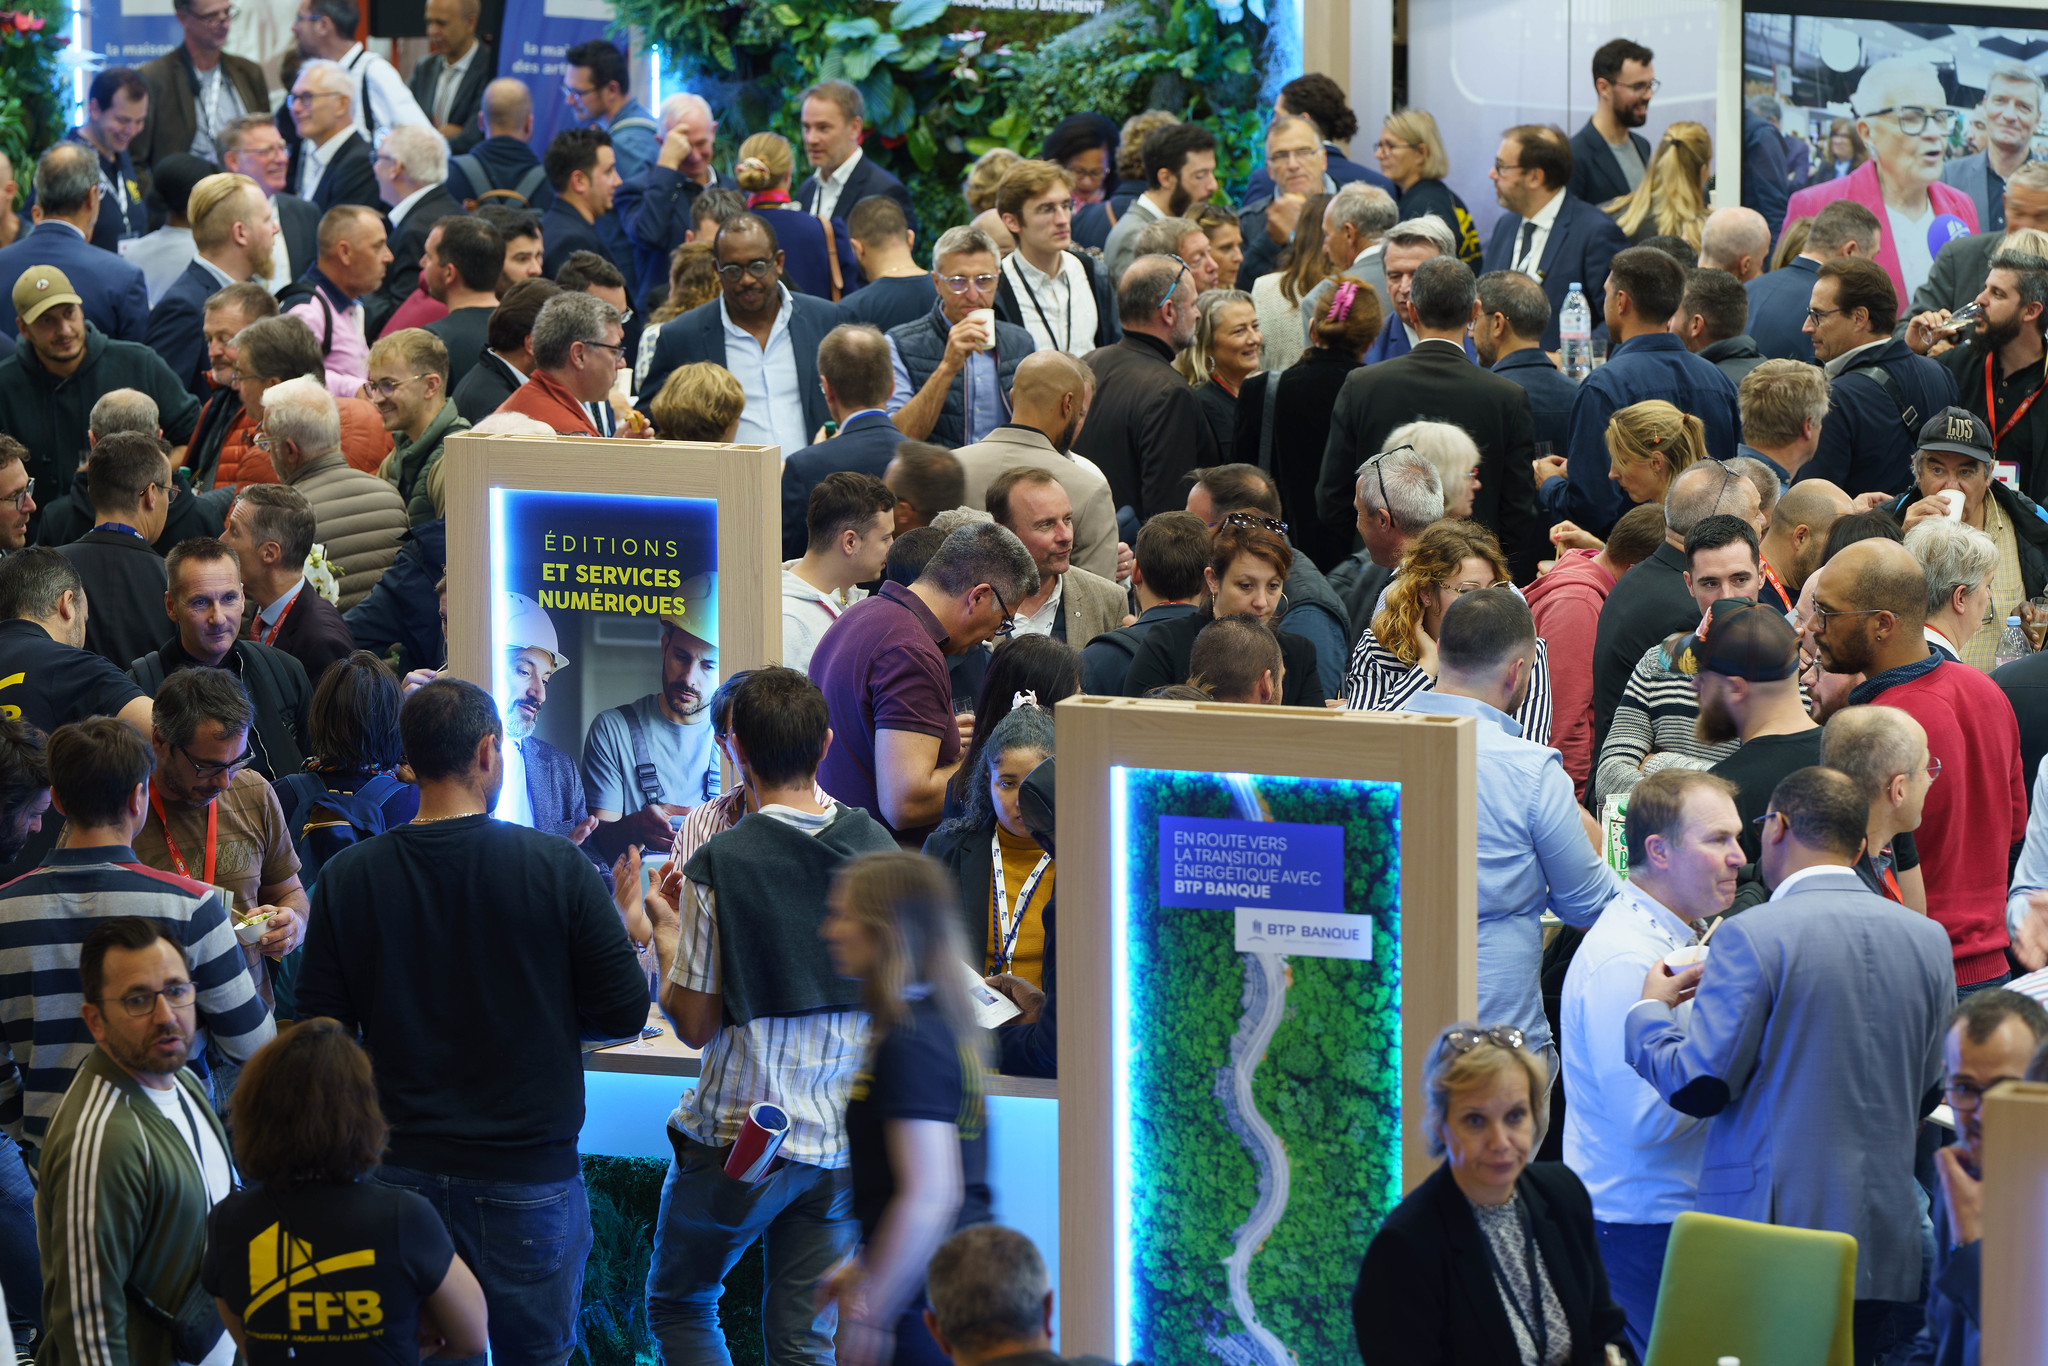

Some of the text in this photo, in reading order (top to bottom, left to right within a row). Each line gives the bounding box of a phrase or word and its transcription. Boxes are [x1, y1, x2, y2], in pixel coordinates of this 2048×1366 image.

[524, 41, 538, 56] la
[512, 59, 539, 74] des
[545, 530, 678, 558] ÉDITIONS
[543, 563, 681, 588] ET SERVICES
[538, 588, 686, 616] NUMÉRIQUES
[1174, 831, 1288, 851] EN ROUTE VERS
[1174, 847, 1282, 867] LA TRANSITION
[1174, 860, 1322, 886] ÉNERGÉTIQUE AVEC
[1174, 880, 1271, 899] BTP BANQUE
[1267, 923, 1360, 941] BTP BANQUE
[288, 1290, 384, 1331] FFB
